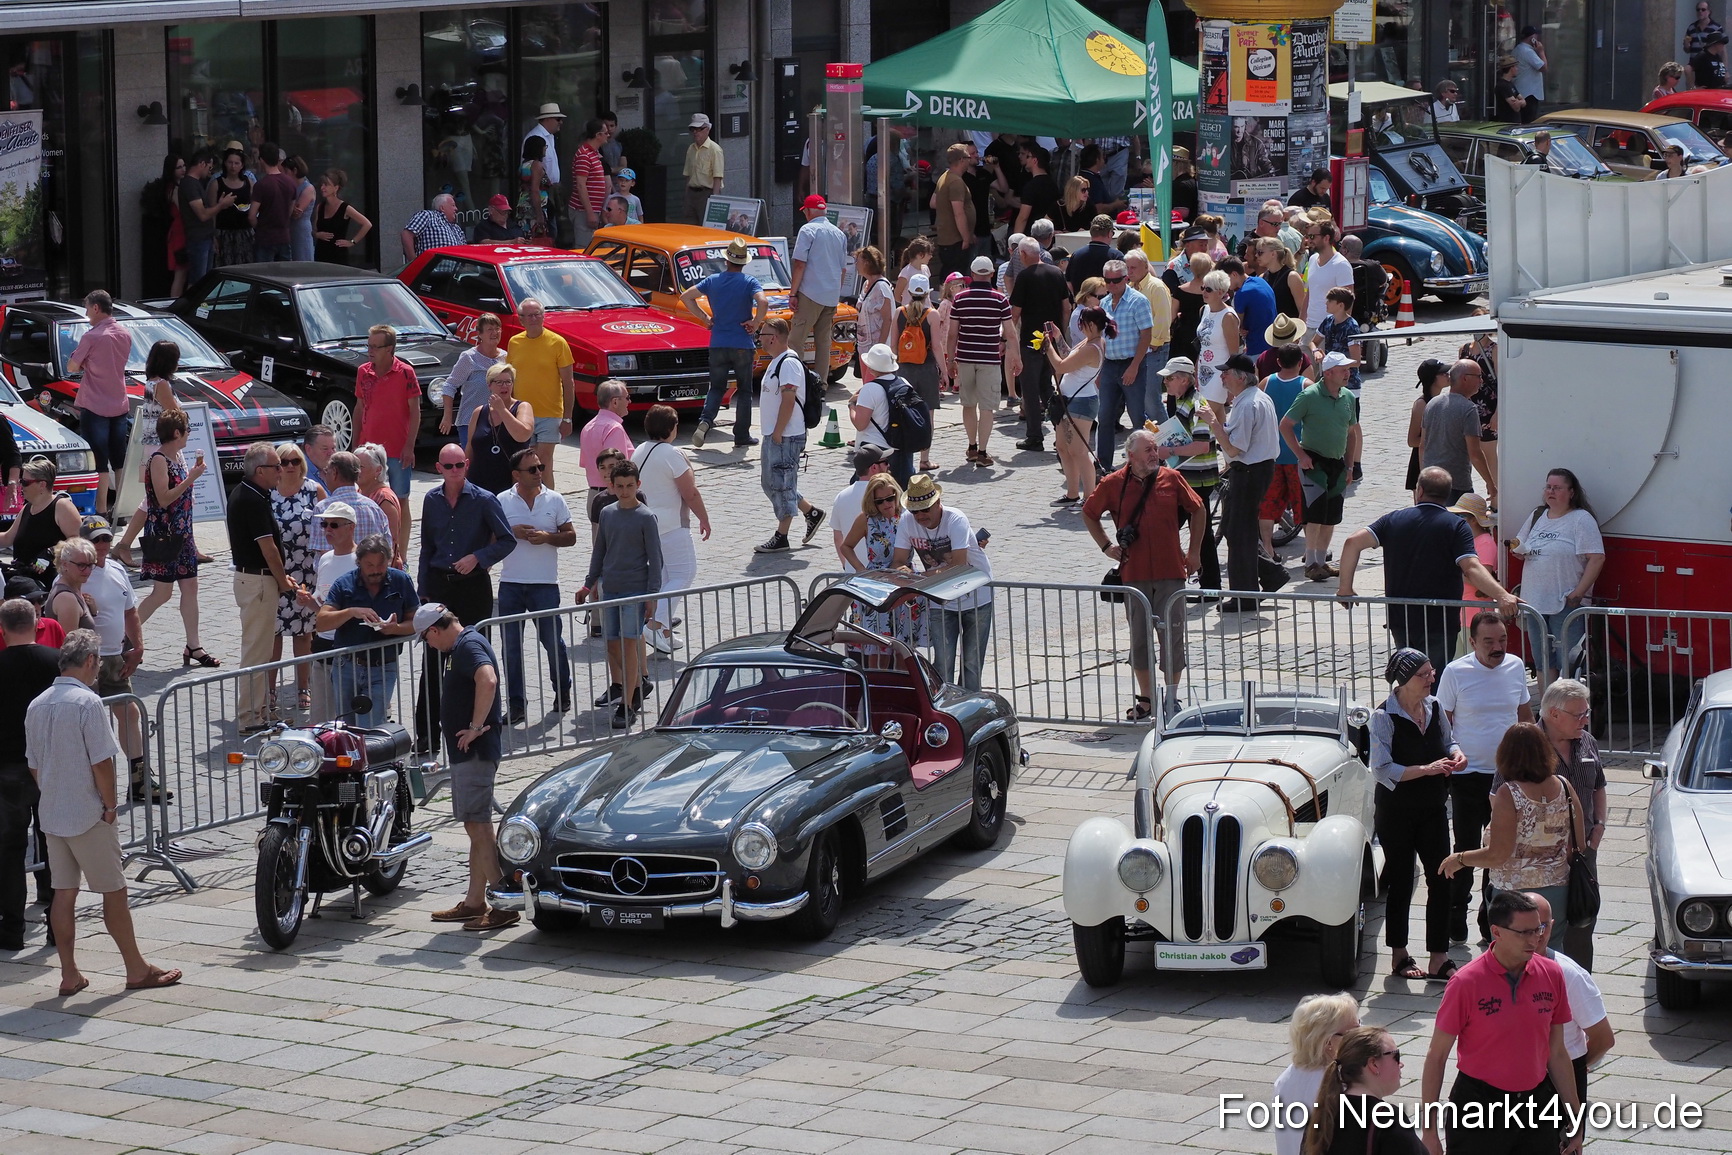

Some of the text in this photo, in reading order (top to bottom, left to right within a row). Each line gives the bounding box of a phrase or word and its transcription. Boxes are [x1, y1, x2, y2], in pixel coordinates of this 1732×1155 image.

[1239, 38, 1258, 47] Park
[836, 66, 844, 77] T
[1147, 41, 1164, 138] DEKRA
[930, 95, 991, 121] DEKRA
[1268, 120, 1286, 129] MARK
[1263, 129, 1286, 138] BENDER
[1270, 142, 1286, 153] BAND
[494, 246, 551, 254] 42
[682, 265, 706, 282] 502
[264, 364, 270, 377] 2
[670, 388, 699, 398] SAPPORO
[56, 442, 80, 450] Castrol
[224, 461, 246, 471] STAR
[1159, 951, 1227, 960] Christian Jakob
